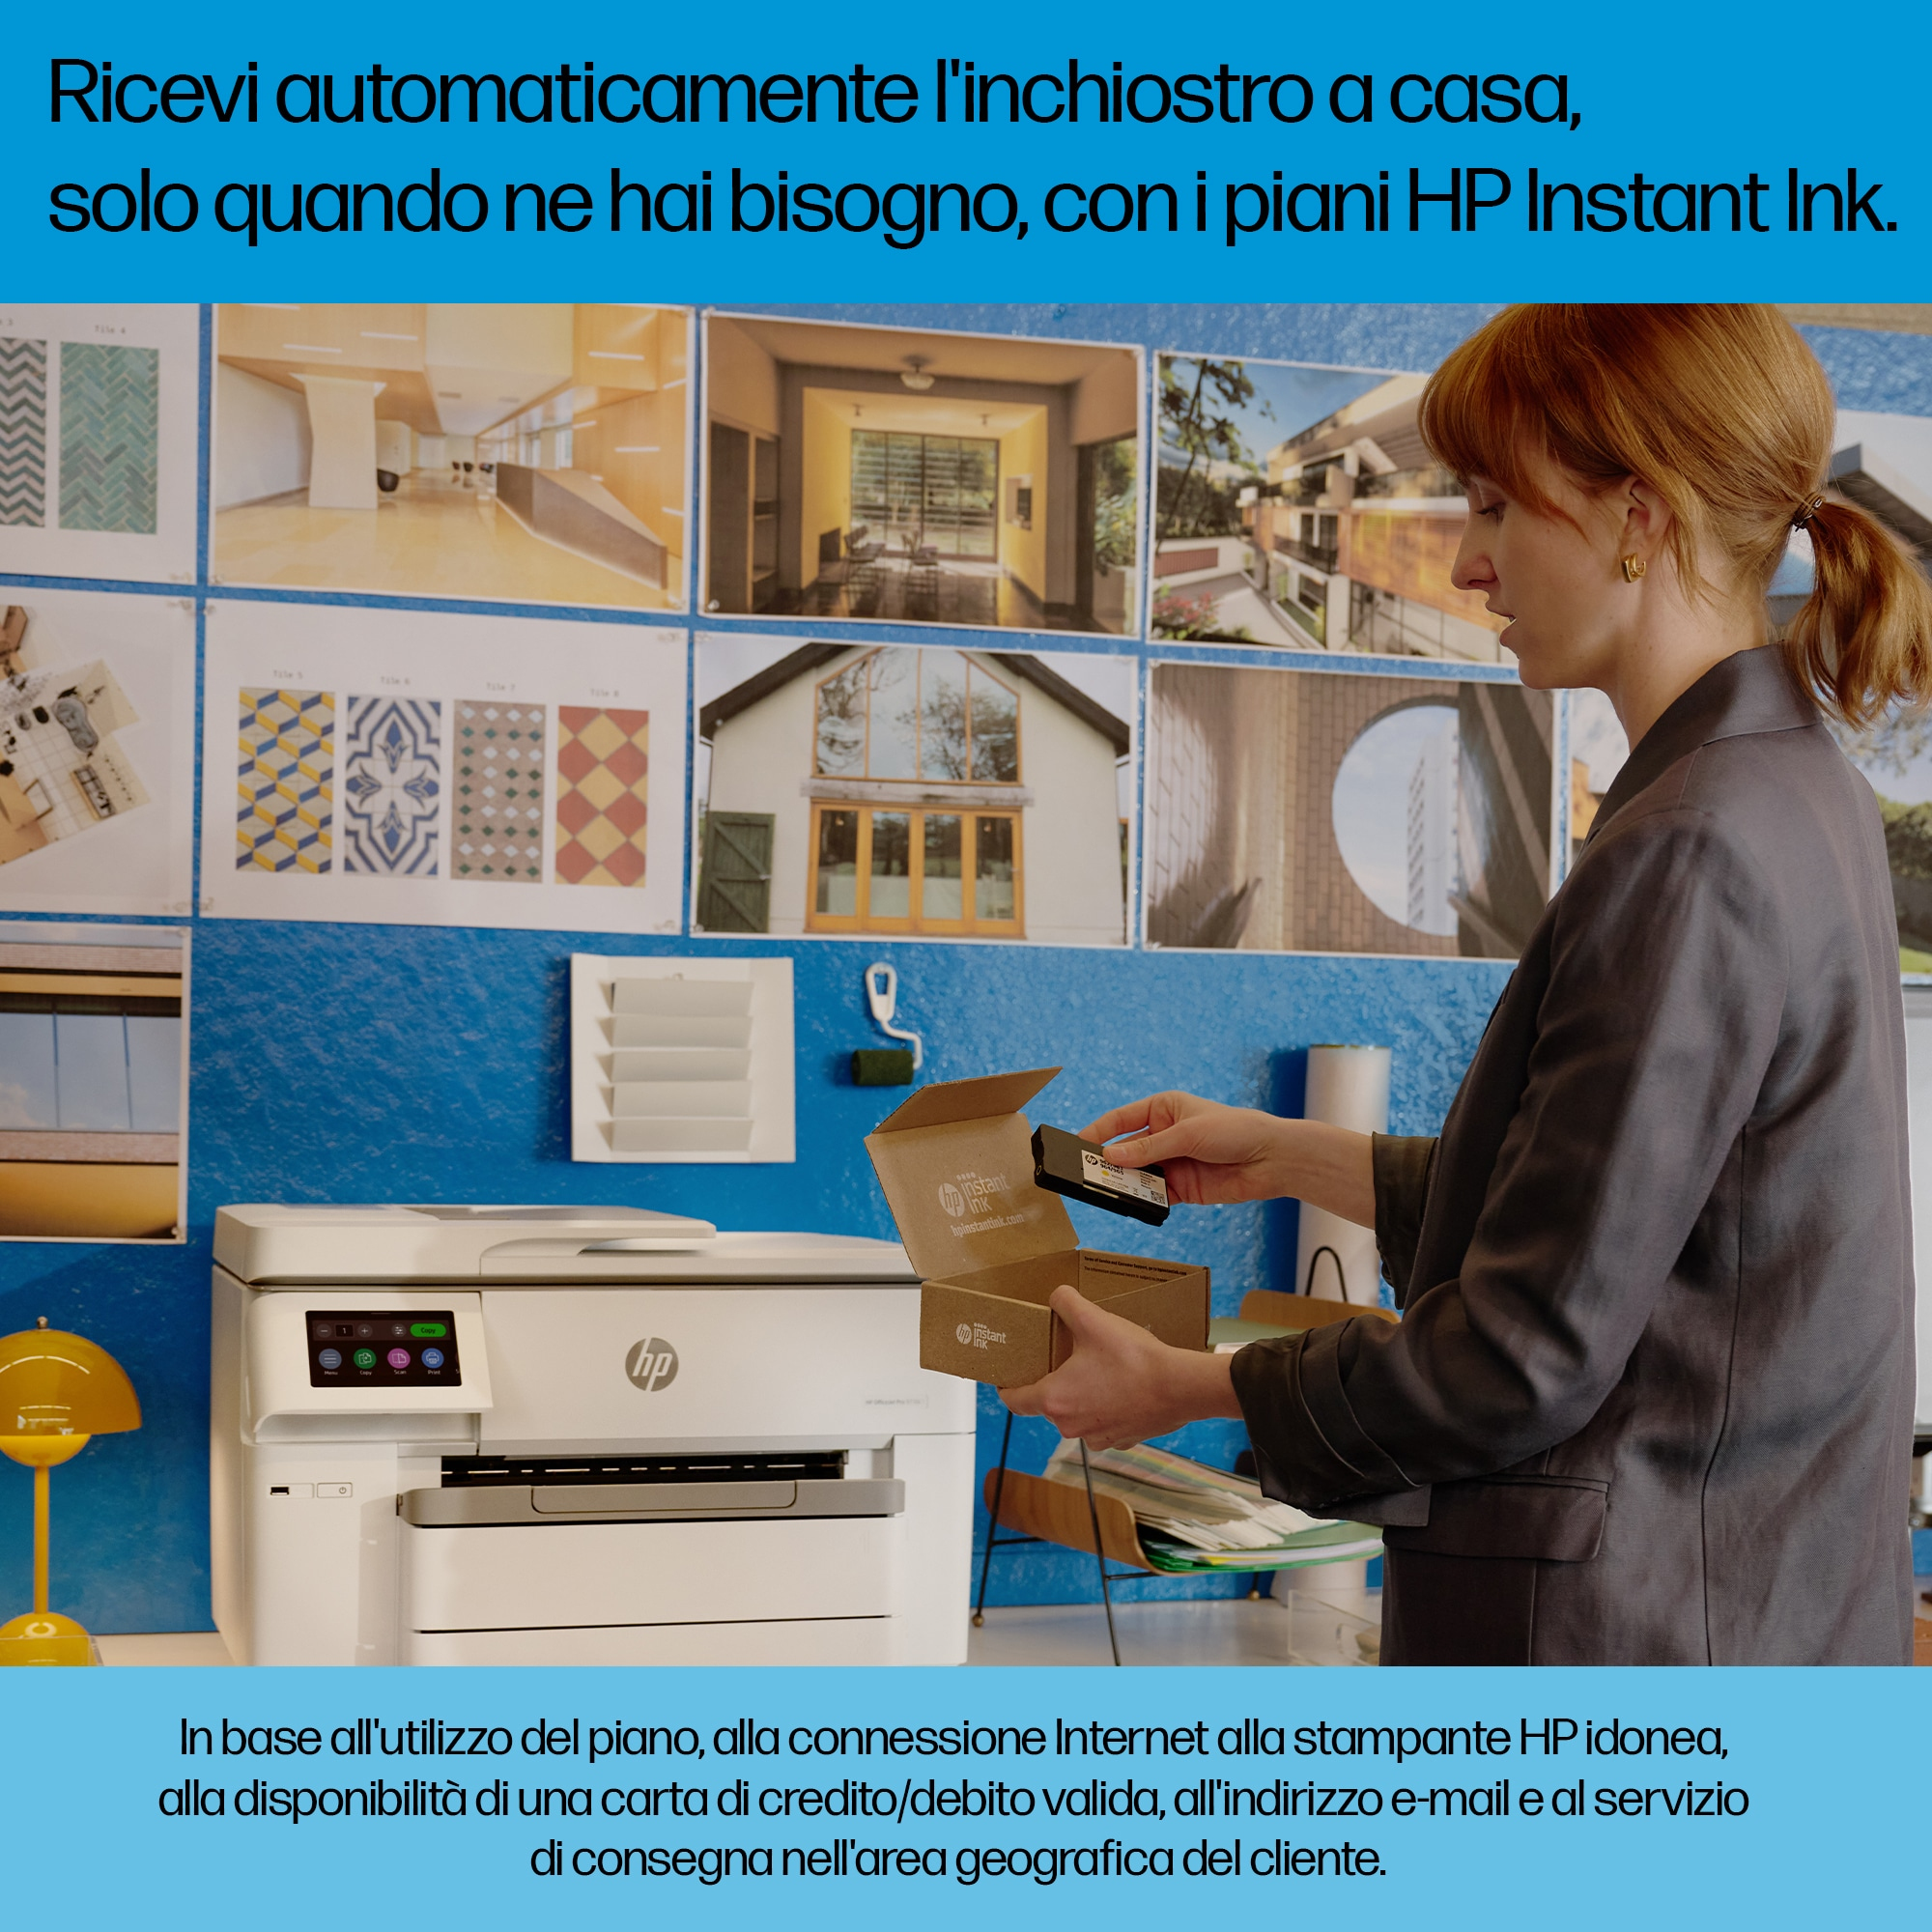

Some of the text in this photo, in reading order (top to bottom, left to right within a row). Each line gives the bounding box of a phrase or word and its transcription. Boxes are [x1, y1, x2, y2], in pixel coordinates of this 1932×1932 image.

[1085, 1153, 1098, 1165] hp
[939, 1182, 964, 1217] hp
[950, 1213, 1025, 1237] hpinstantink.com
[956, 1323, 972, 1344] hp
[628, 1337, 676, 1392] hp
